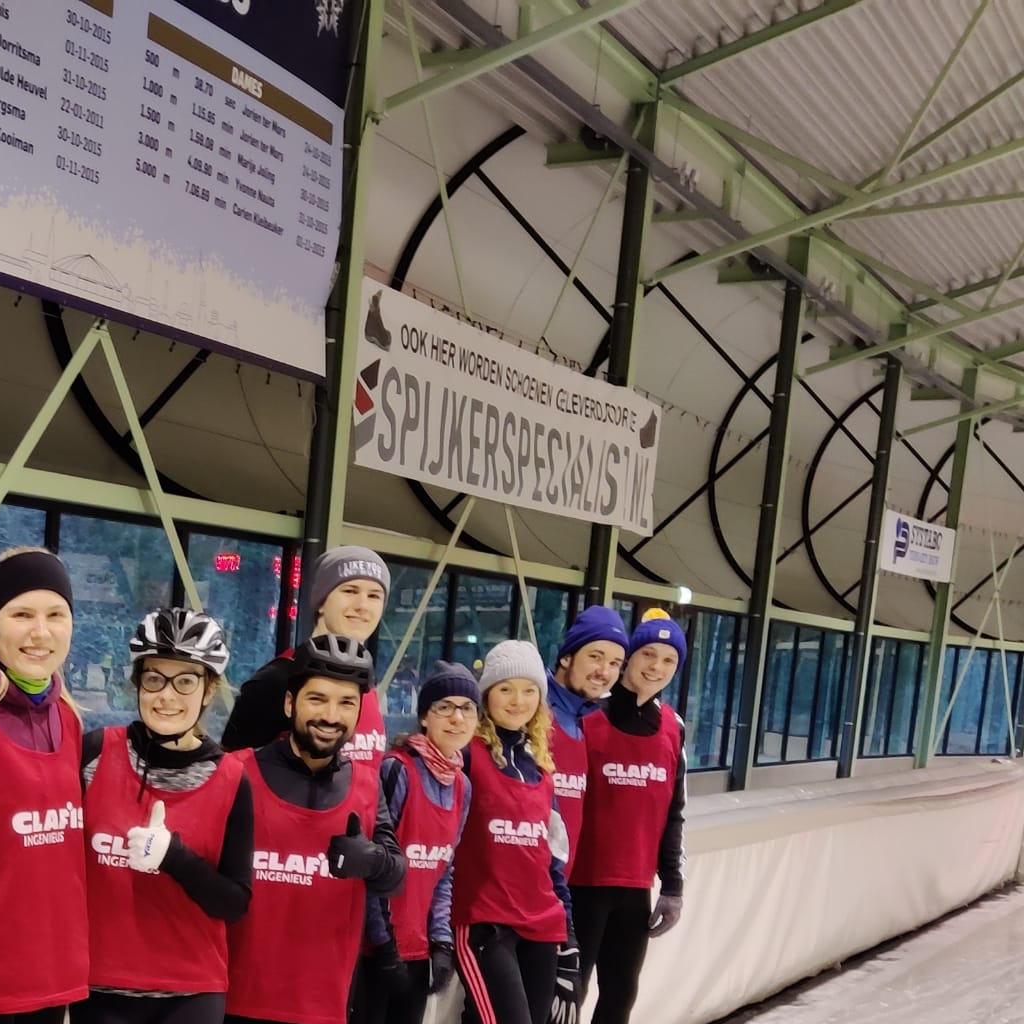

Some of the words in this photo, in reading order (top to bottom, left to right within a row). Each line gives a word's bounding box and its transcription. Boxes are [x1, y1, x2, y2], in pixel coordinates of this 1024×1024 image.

[66, 9, 112, 45] 30-10-2015
[65, 39, 109, 72] 01-11-2015
[145, 49, 160, 67] 500
[63, 68, 107, 101] 31-10-2015
[143, 76, 164, 98] 1.000
[231, 66, 264, 98] DAMES
[17, 74, 48, 100] Heuvel
[60, 97, 104, 129] 22-01-2011
[57, 126, 102, 157] 30-10-2015
[138, 131, 160, 152] 3.000
[56, 154, 100, 184] 01-11-2015
[136, 158, 157, 178] 5.000
[400, 323, 428, 358] OOK
[430, 334, 456, 369] HIER
[459, 345, 503, 387] WORDEN
[505, 365, 554, 408] SCHOENEN
[23, 831, 65, 847] INGENIEUS
[256, 870, 313, 886] INGENIEUS
